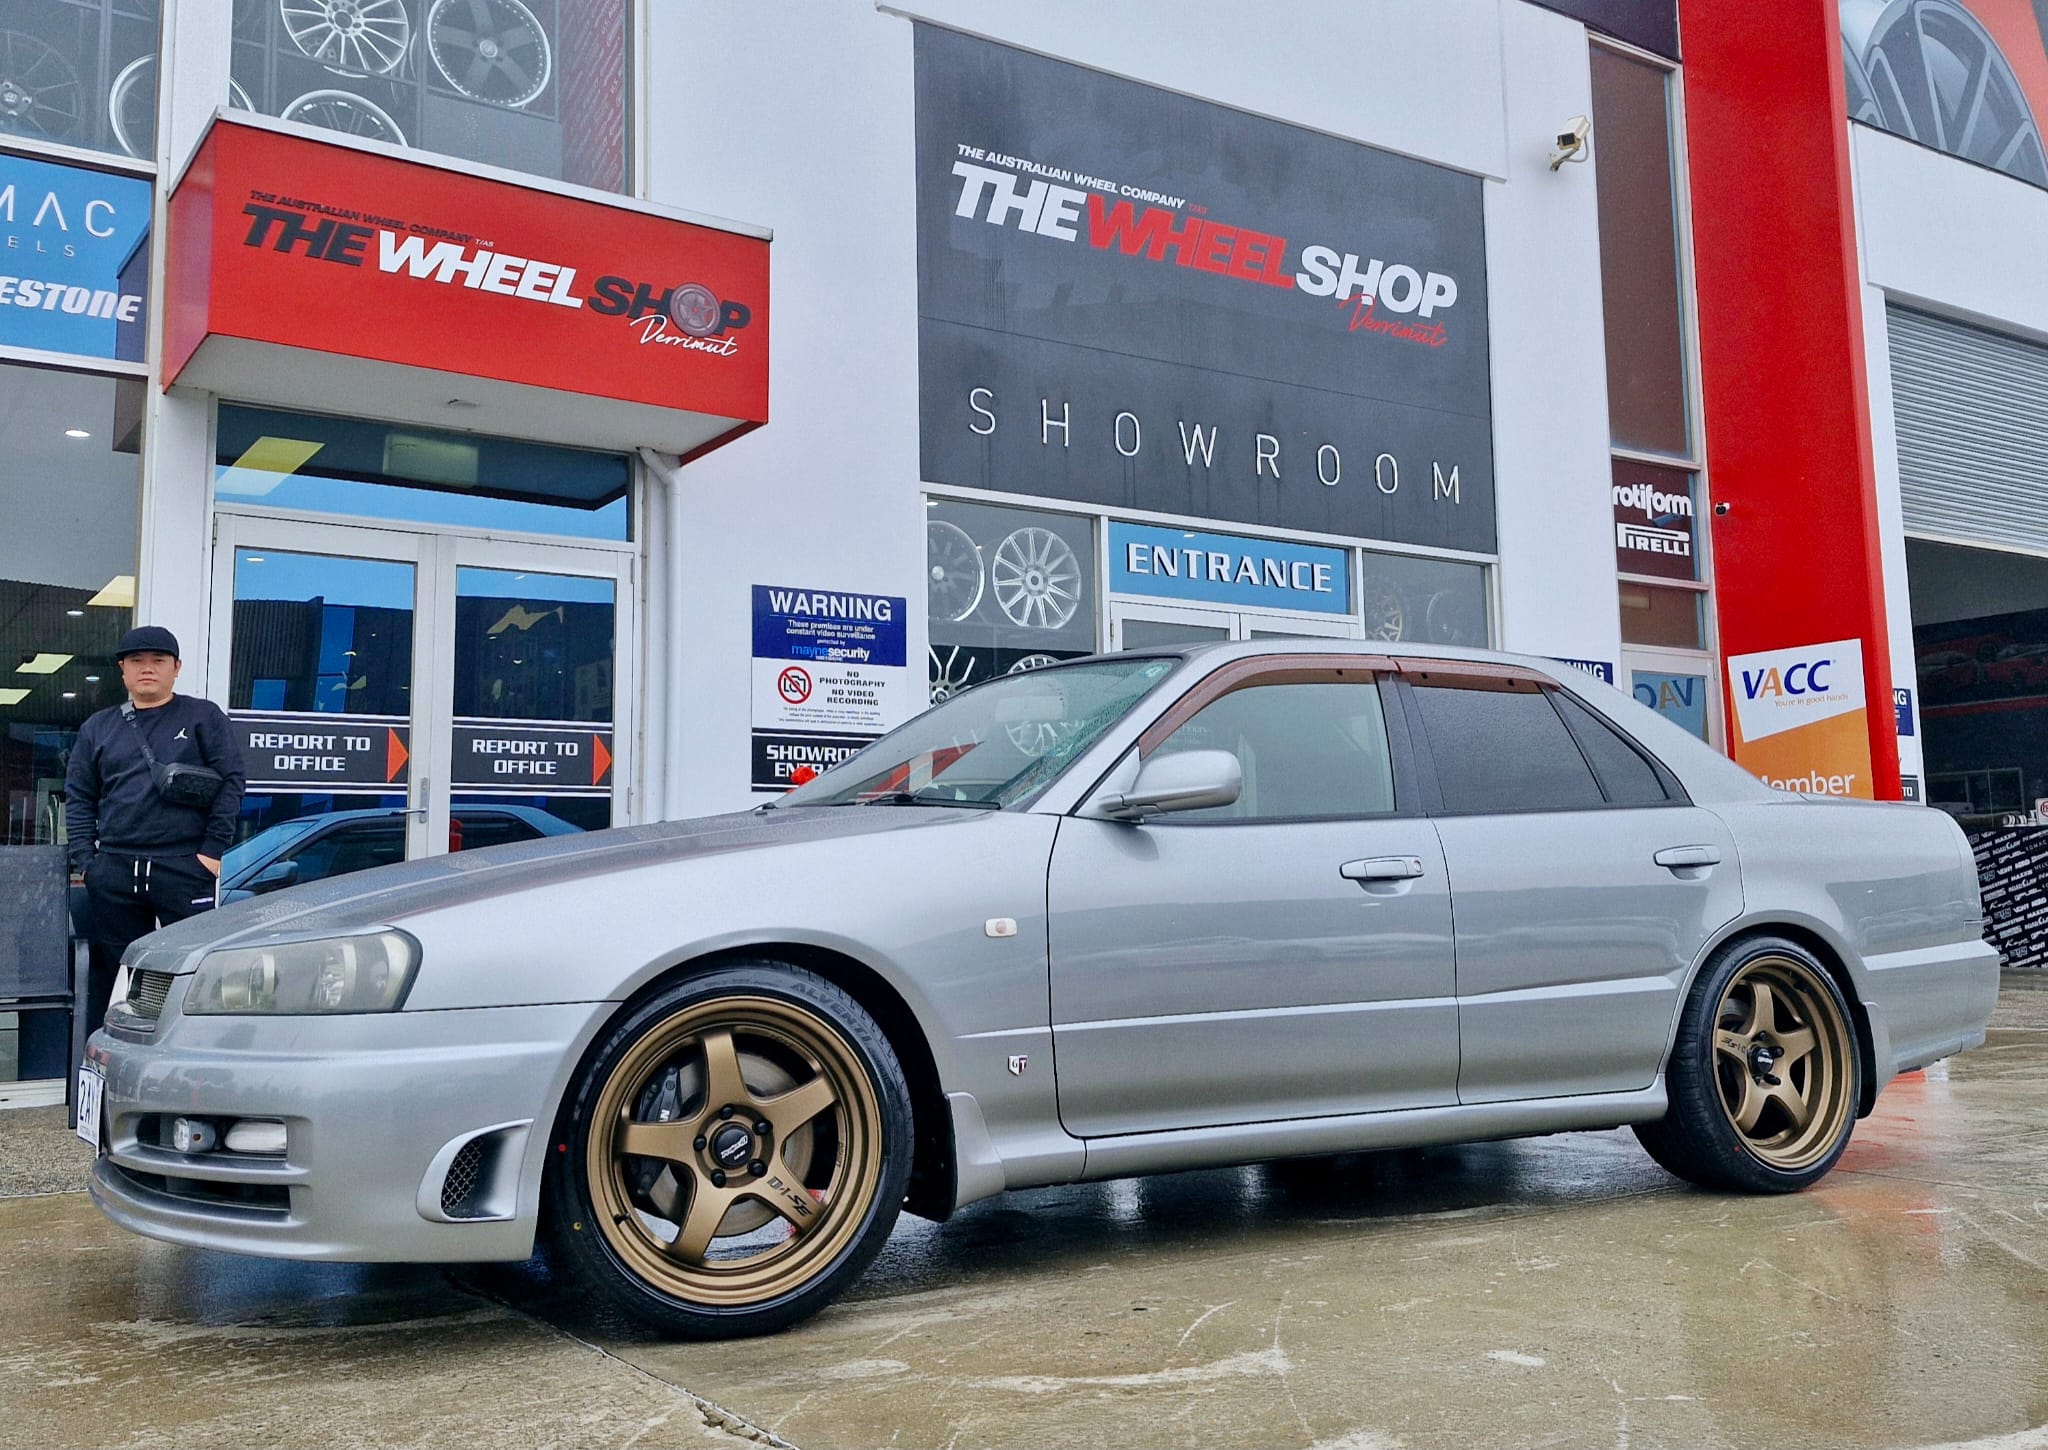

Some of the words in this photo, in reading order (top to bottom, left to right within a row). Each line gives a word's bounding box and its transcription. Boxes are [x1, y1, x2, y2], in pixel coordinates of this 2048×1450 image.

[956, 143, 986, 161] THE
[986, 151, 1072, 183] AUSTRALIAN
[1073, 172, 1119, 194] WHEEL
[1120, 184, 1186, 209] COMPANY
[250, 190, 277, 203] THE
[277, 197, 361, 221] AUSTRALIAN
[363, 214, 406, 230] WHEEL
[409, 223, 474, 243] COMPANY
[242, 203, 375, 267] THE
[379, 229, 584, 309] WHEEL
[951, 160, 1088, 242] THE
[1087, 192, 1296, 290] WHEEL
[1295, 245, 1458, 318] SHOP
[630, 314, 738, 356] Derrimut
[968, 387, 1460, 505] SHOWROOM
[1613, 484, 1694, 520] rotiform
[1616, 522, 1690, 556] PIRELLI
[1126, 542, 1333, 593] ENTRANCE
[769, 590, 892, 622] WARNING
[786, 627, 815, 636] constant
[819, 677, 886, 688] PHOTOGRAPHY
[1741, 659, 1831, 699] VACC
[826, 696, 879, 706] RECORDING
[1806, 695, 1825, 706] good
[1826, 693, 1849, 703] hands
[249, 733, 337, 751] REPORT
[343, 736, 371, 751] TO
[472, 739, 550, 756] REPORT
[554, 742, 579, 757] TO
[273, 755, 346, 771] OFFICE
[493, 759, 558, 775] OFFICE
